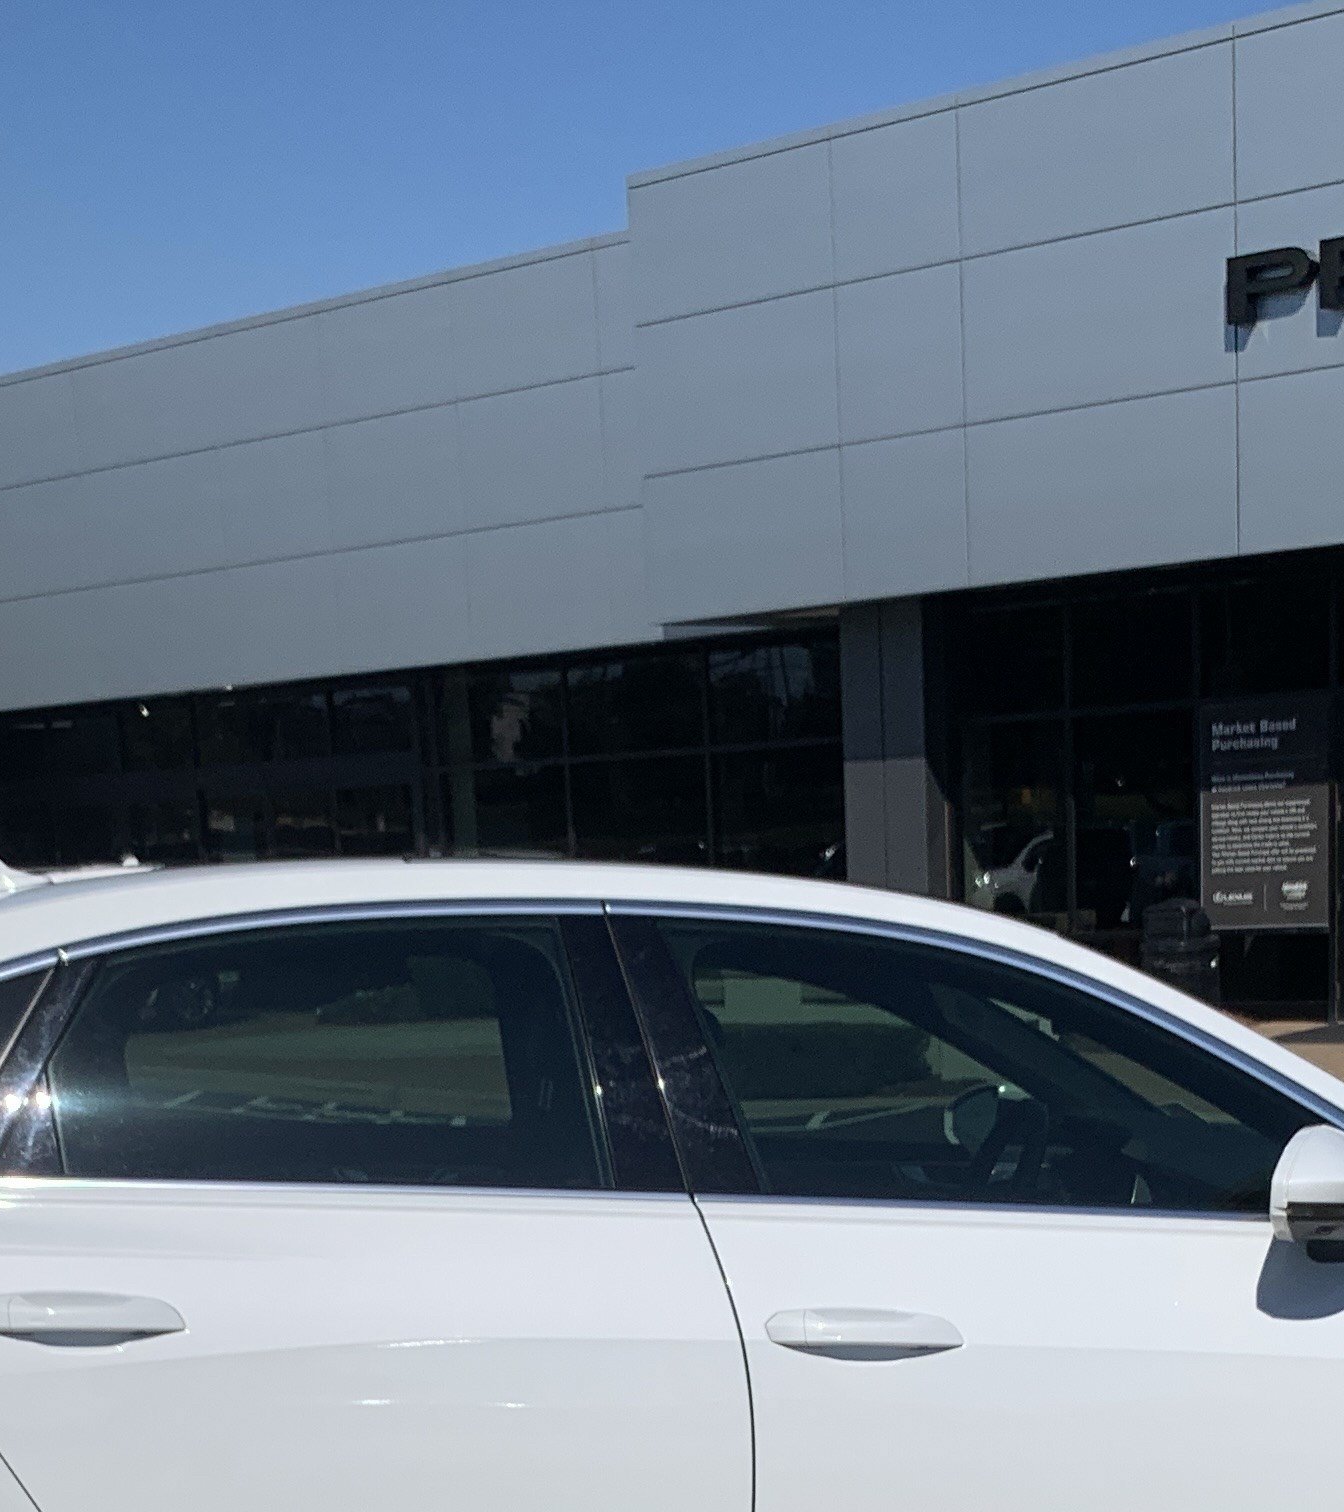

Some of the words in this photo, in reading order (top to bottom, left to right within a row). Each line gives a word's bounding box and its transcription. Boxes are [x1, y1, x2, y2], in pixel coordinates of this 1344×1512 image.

[1211, 721, 1256, 735] Market
[1259, 718, 1296, 732] Based
[1211, 737, 1278, 751] Purchasing
